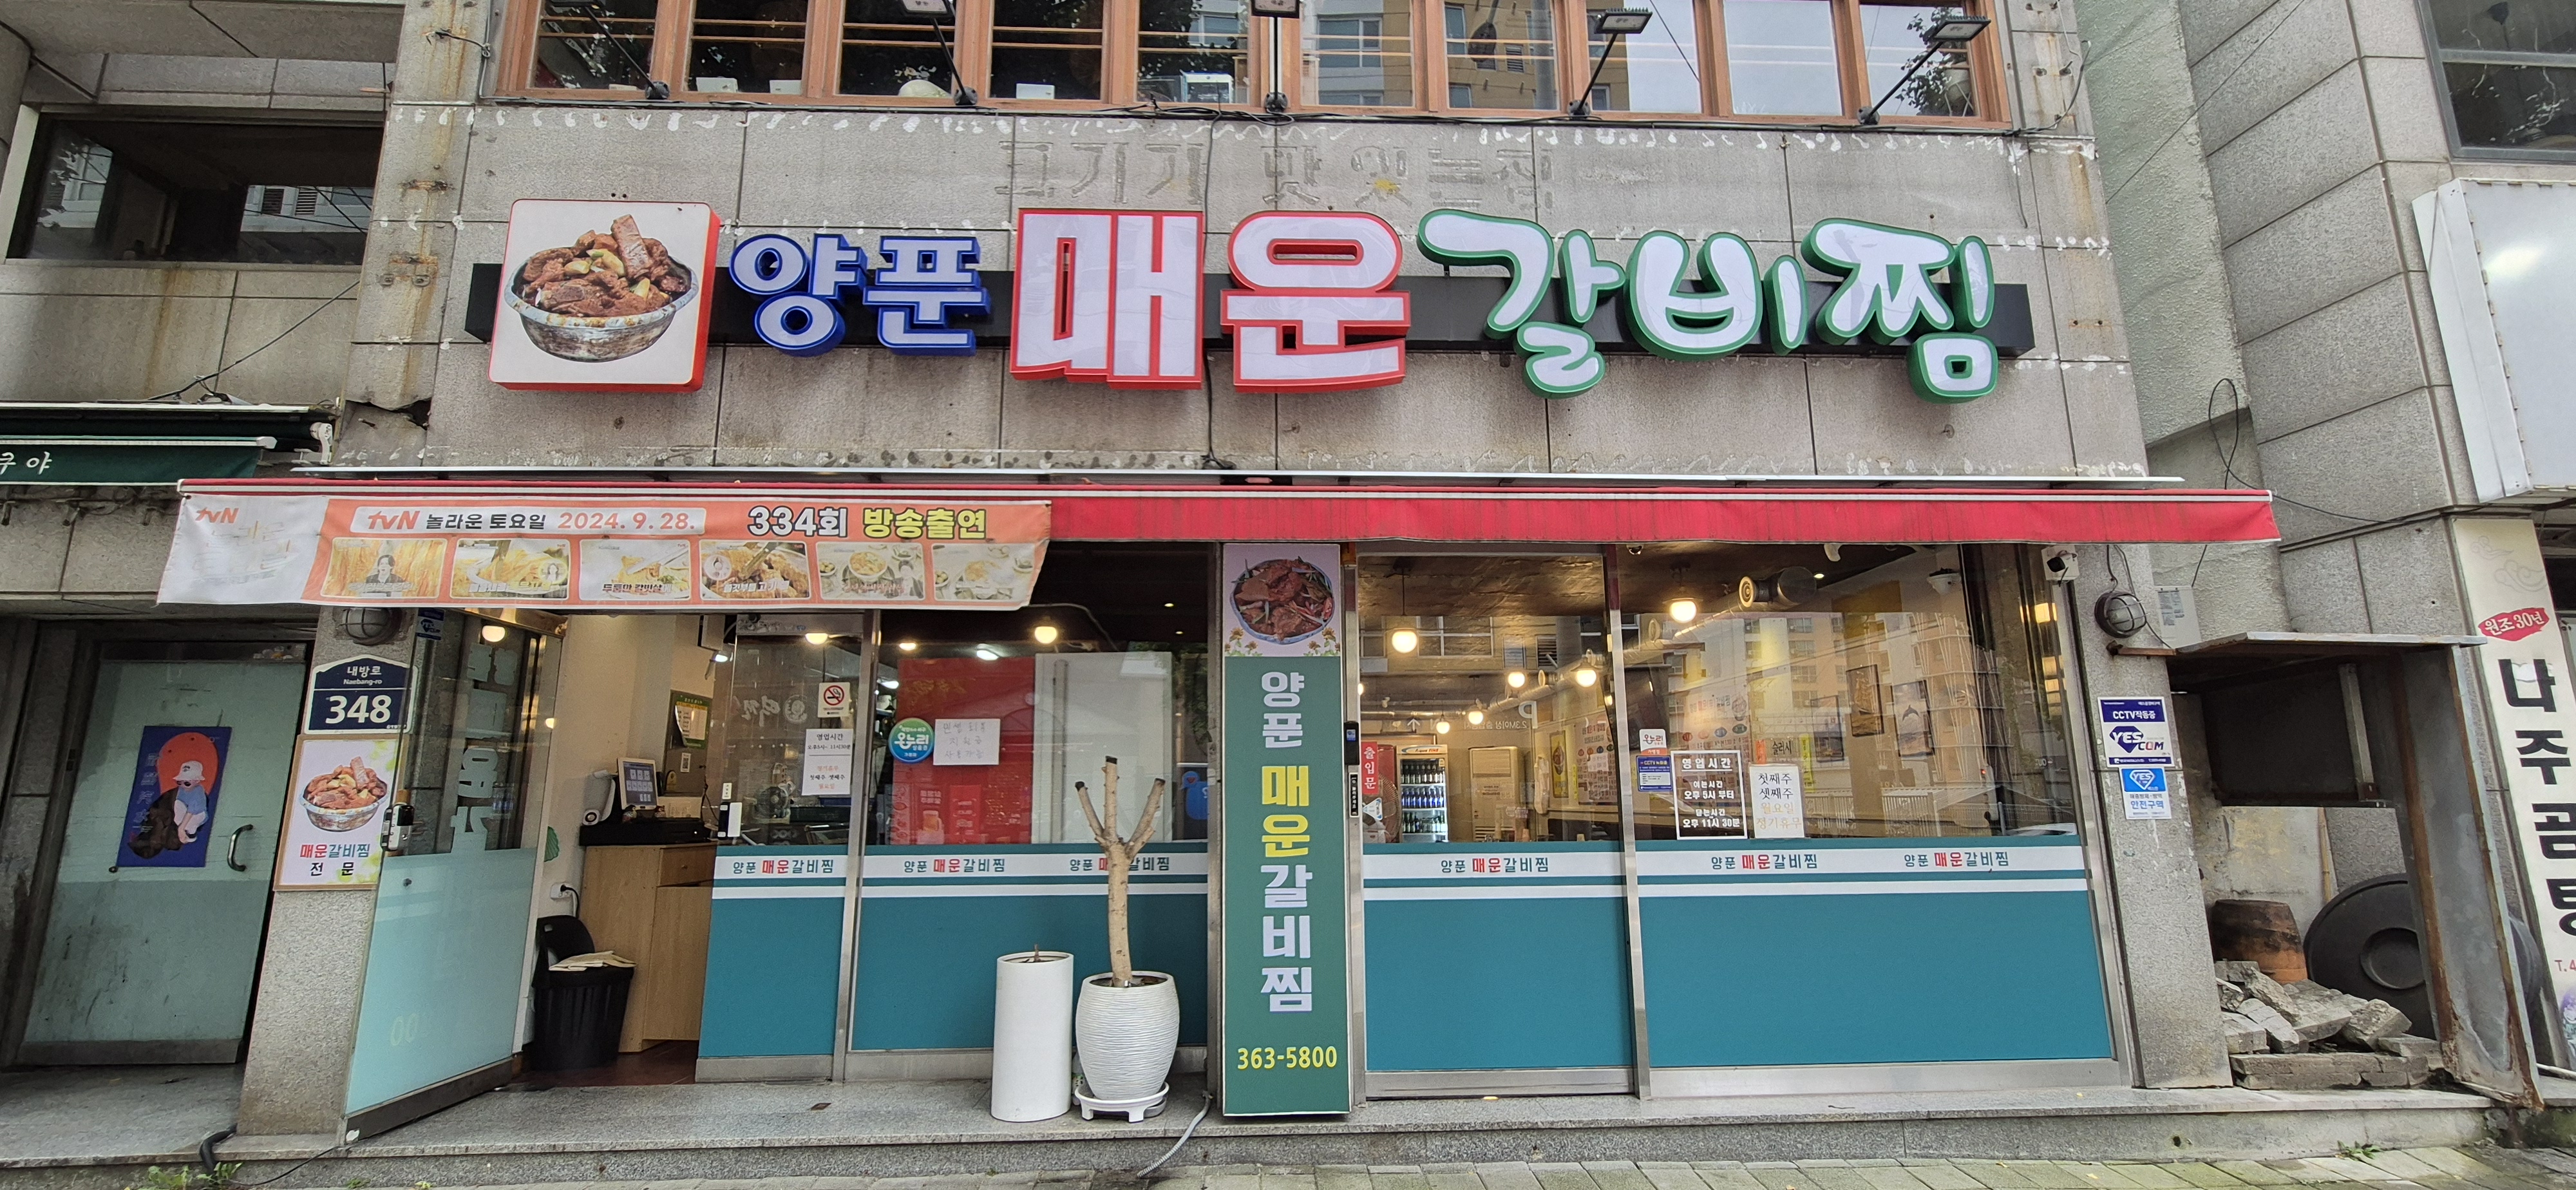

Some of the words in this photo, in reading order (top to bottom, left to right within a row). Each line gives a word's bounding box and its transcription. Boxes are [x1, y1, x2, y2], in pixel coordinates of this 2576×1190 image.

[728, 233, 992, 357] 양푼
[1009, 207, 1411, 393] 매운
[1417, 207, 1999, 404] 갈비찜
[195, 507, 239, 524] tvN
[368, 511, 420, 530] tvN
[426, 513, 483, 531] 놀라운
[489, 513, 546, 530] 토요일
[559, 513, 626, 530] 2024.
[632, 513, 653, 530] 9.
[660, 513, 695, 530] 28.
[747, 505, 848, 538] 334회
[862, 507, 987, 540] 방송출연
[2485, 619, 2515, 636] 원조
[2513, 611, 2545, 628] 30년
[347, 666, 381, 677] 내방로
[325, 695, 392, 724] 348
[1261, 671, 1305, 748] 양푼
[894, 732, 929, 750] 온누리
[1643, 734, 1663, 744] 온누리
[2112, 732, 2142, 744] YES
[2138, 742, 2164, 750] COM
[1772, 741, 1792, 755] 슬러시
[1363, 746, 1377, 789] 출입문
[1681, 758, 1731, 769] 영업시간
[1758, 773, 1792, 785] 첫째주
[1684, 790, 1700, 800] 오후
[1703, 791, 1716, 799] 5시
[1718, 790, 1735, 799] 부터
[1759, 788, 1794, 799] 셋째주
[1761, 802, 1794, 815] 월요일
[2130, 800, 2164, 809] 안전구역
[1683, 818, 1699, 828] 오후
[1701, 818, 1719, 828] 11시
[1722, 818, 1741, 827] 30분
[1756, 817, 1802, 829] 정기휴무
[299, 844, 370, 858] 매운갈비찜
[733, 861, 756, 874] 양푼
[762, 858, 834, 874] 매운갈비찜
[904, 860, 927, 873] 양푼
[933, 858, 1005, 873] 매운갈비찜
[1070, 859, 1092, 871] 양푼
[1441, 860, 1466, 873] 양푼
[1472, 857, 1549, 873] 매운갈비찜
[1711, 856, 1736, 869] 양푼
[1741, 854, 1817, 869] 매운갈비찜
[1904, 854, 1929, 867] 양푼
[1934, 851, 2009, 867] 매운갈비찜
[1260, 765, 1312, 1014] 매운갈비찜
[1237, 1046, 1338, 1070] 363-5800
